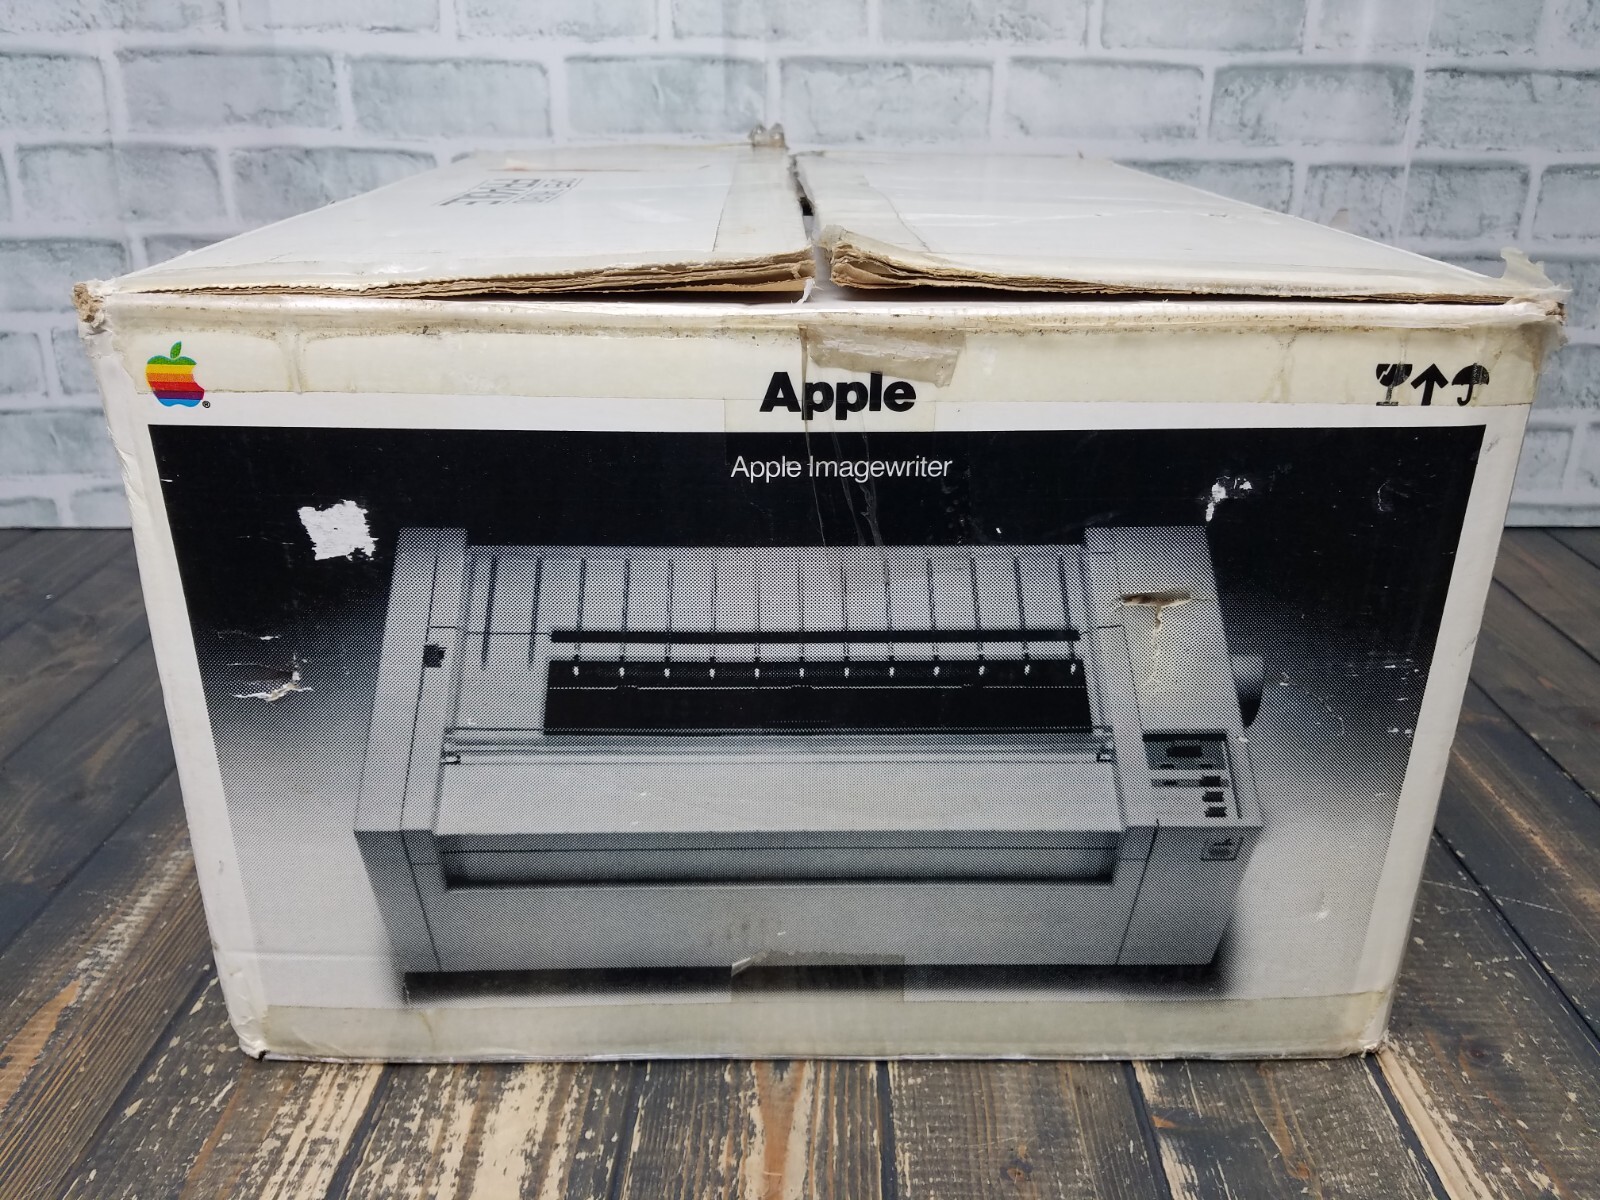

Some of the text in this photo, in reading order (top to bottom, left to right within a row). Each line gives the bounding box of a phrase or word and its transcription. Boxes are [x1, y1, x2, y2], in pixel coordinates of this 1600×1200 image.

[760, 371, 916, 420] Apple
[731, 455, 953, 484] Apple Imagewriter
